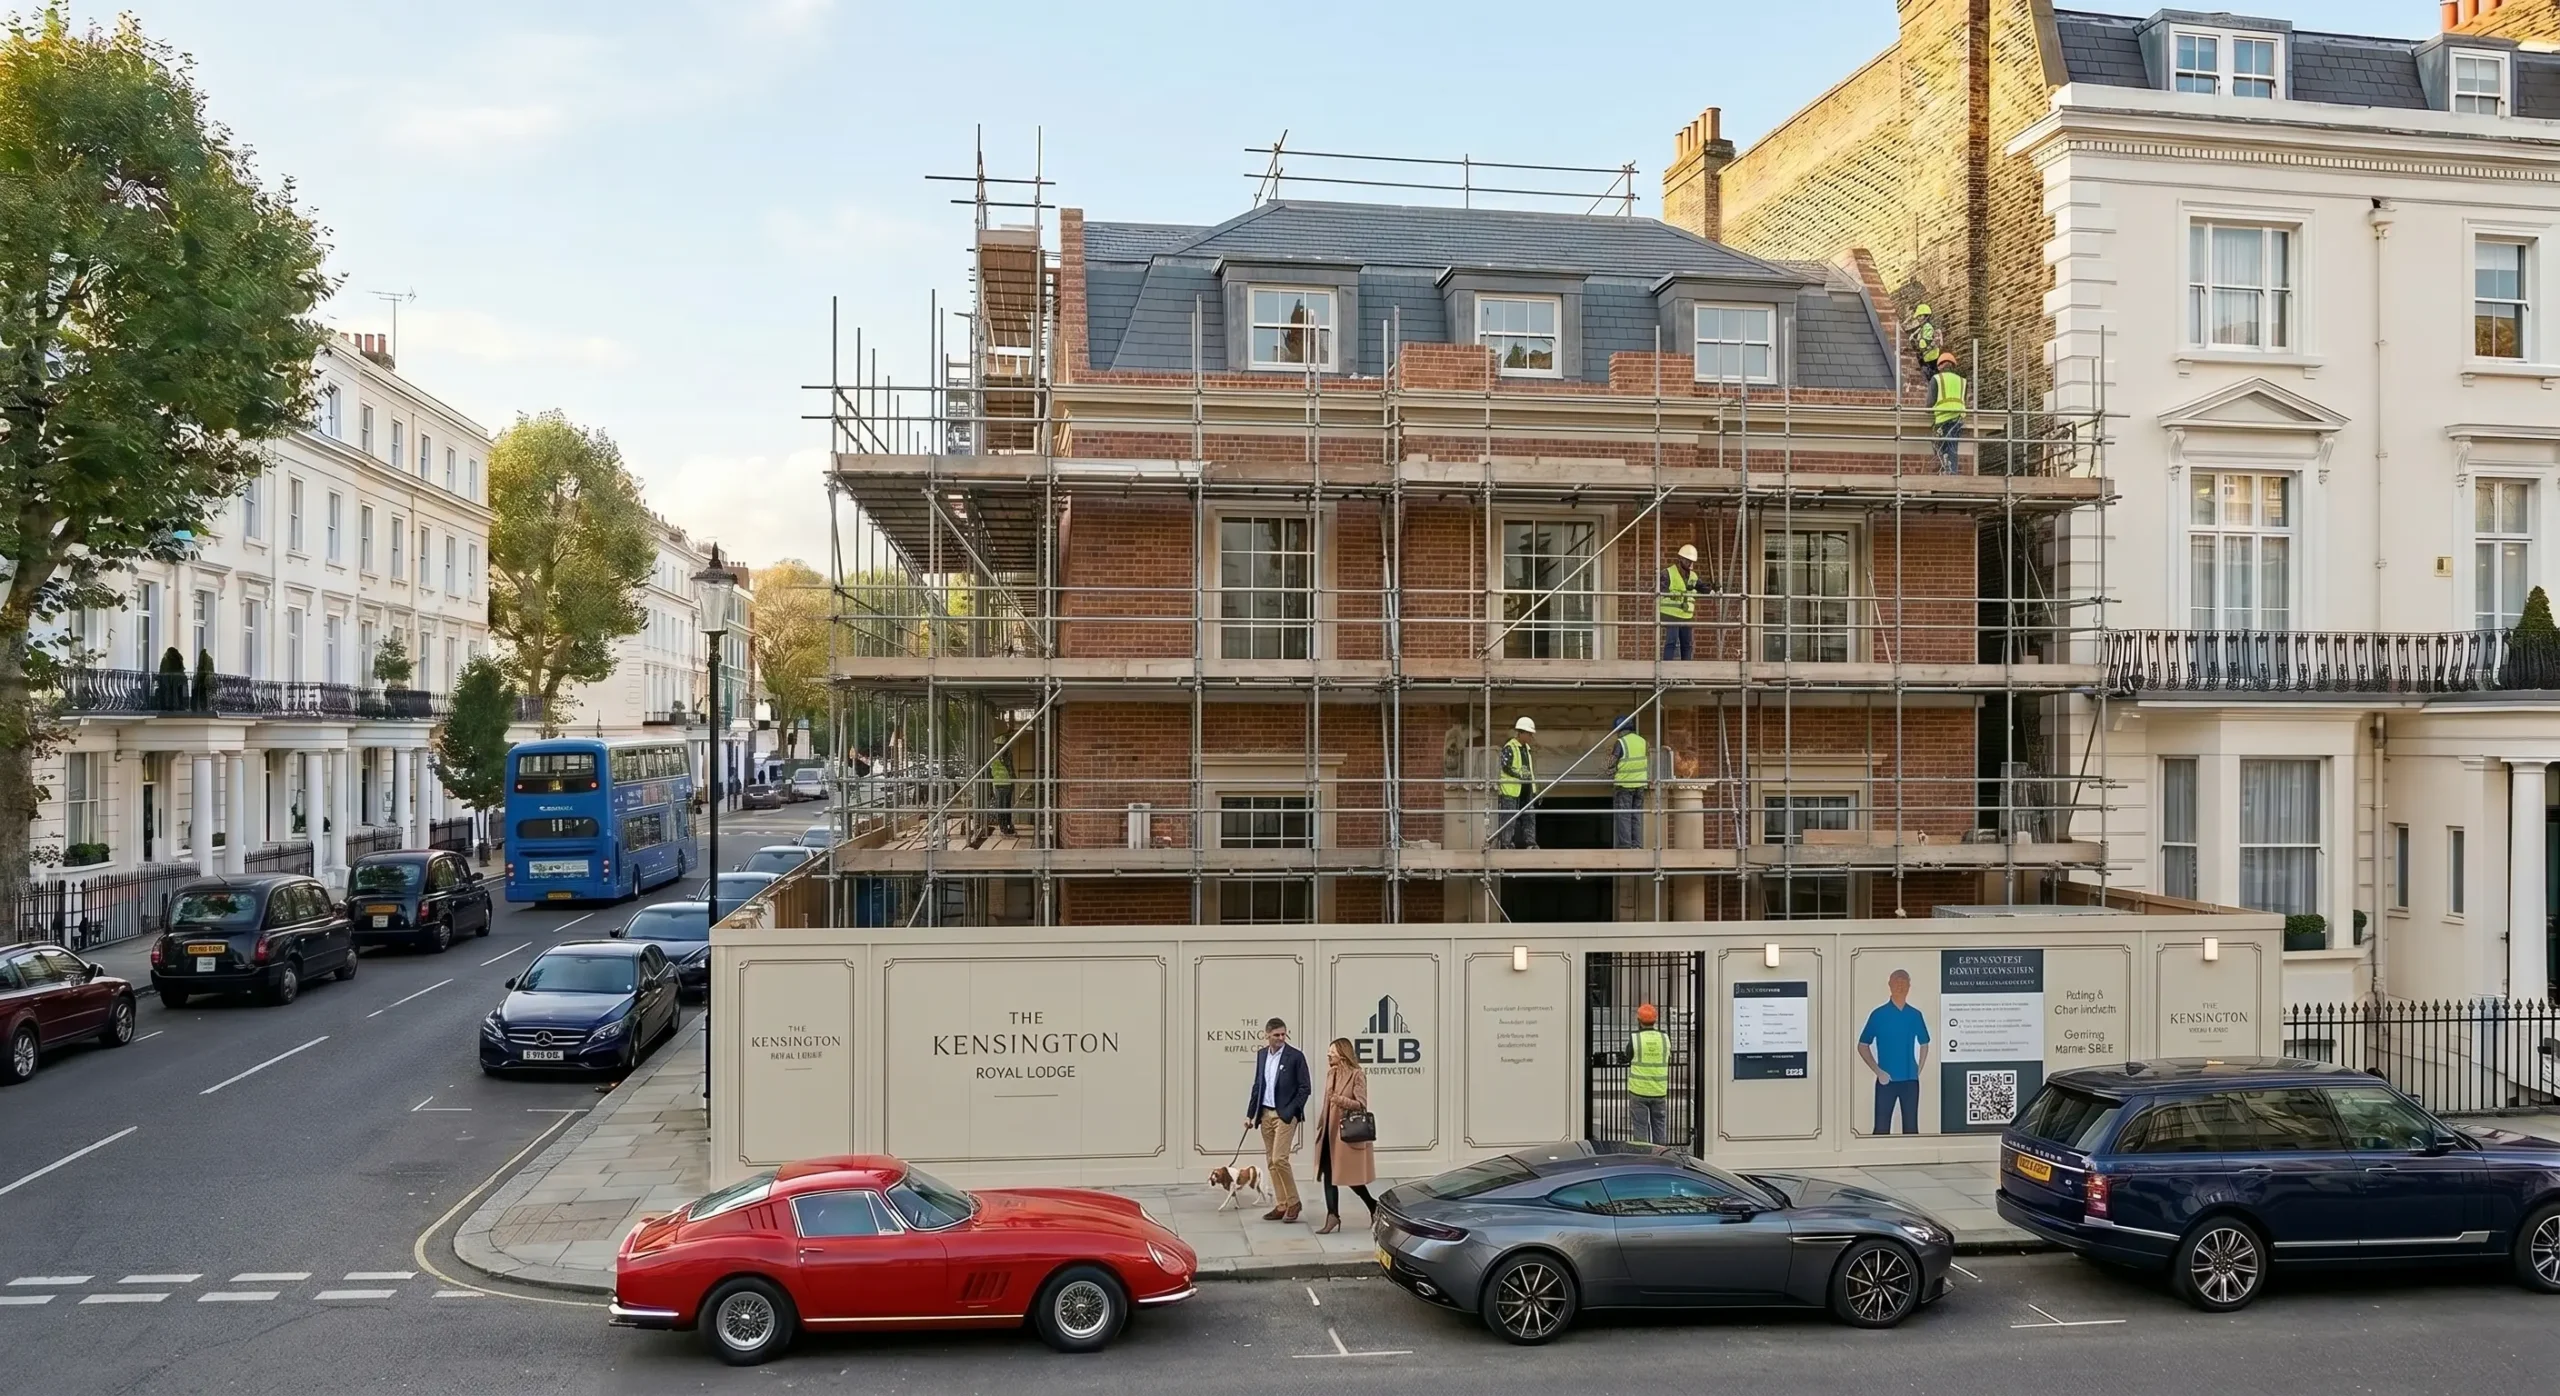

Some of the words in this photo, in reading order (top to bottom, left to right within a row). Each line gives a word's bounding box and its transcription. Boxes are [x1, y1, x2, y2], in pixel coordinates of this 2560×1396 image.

[1009, 1011, 1044, 1025] THE
[1242, 1018, 1259, 1027] THE
[2170, 1012, 2248, 1024] KENSINGTON
[751, 1035, 841, 1048] KENSINGTON
[933, 1032, 1119, 1055] KENSINGTON
[1355, 1038, 1421, 1064] ELB
[976, 1066, 1023, 1079] ROYAL
[1027, 1065, 1076, 1079] LODGE
